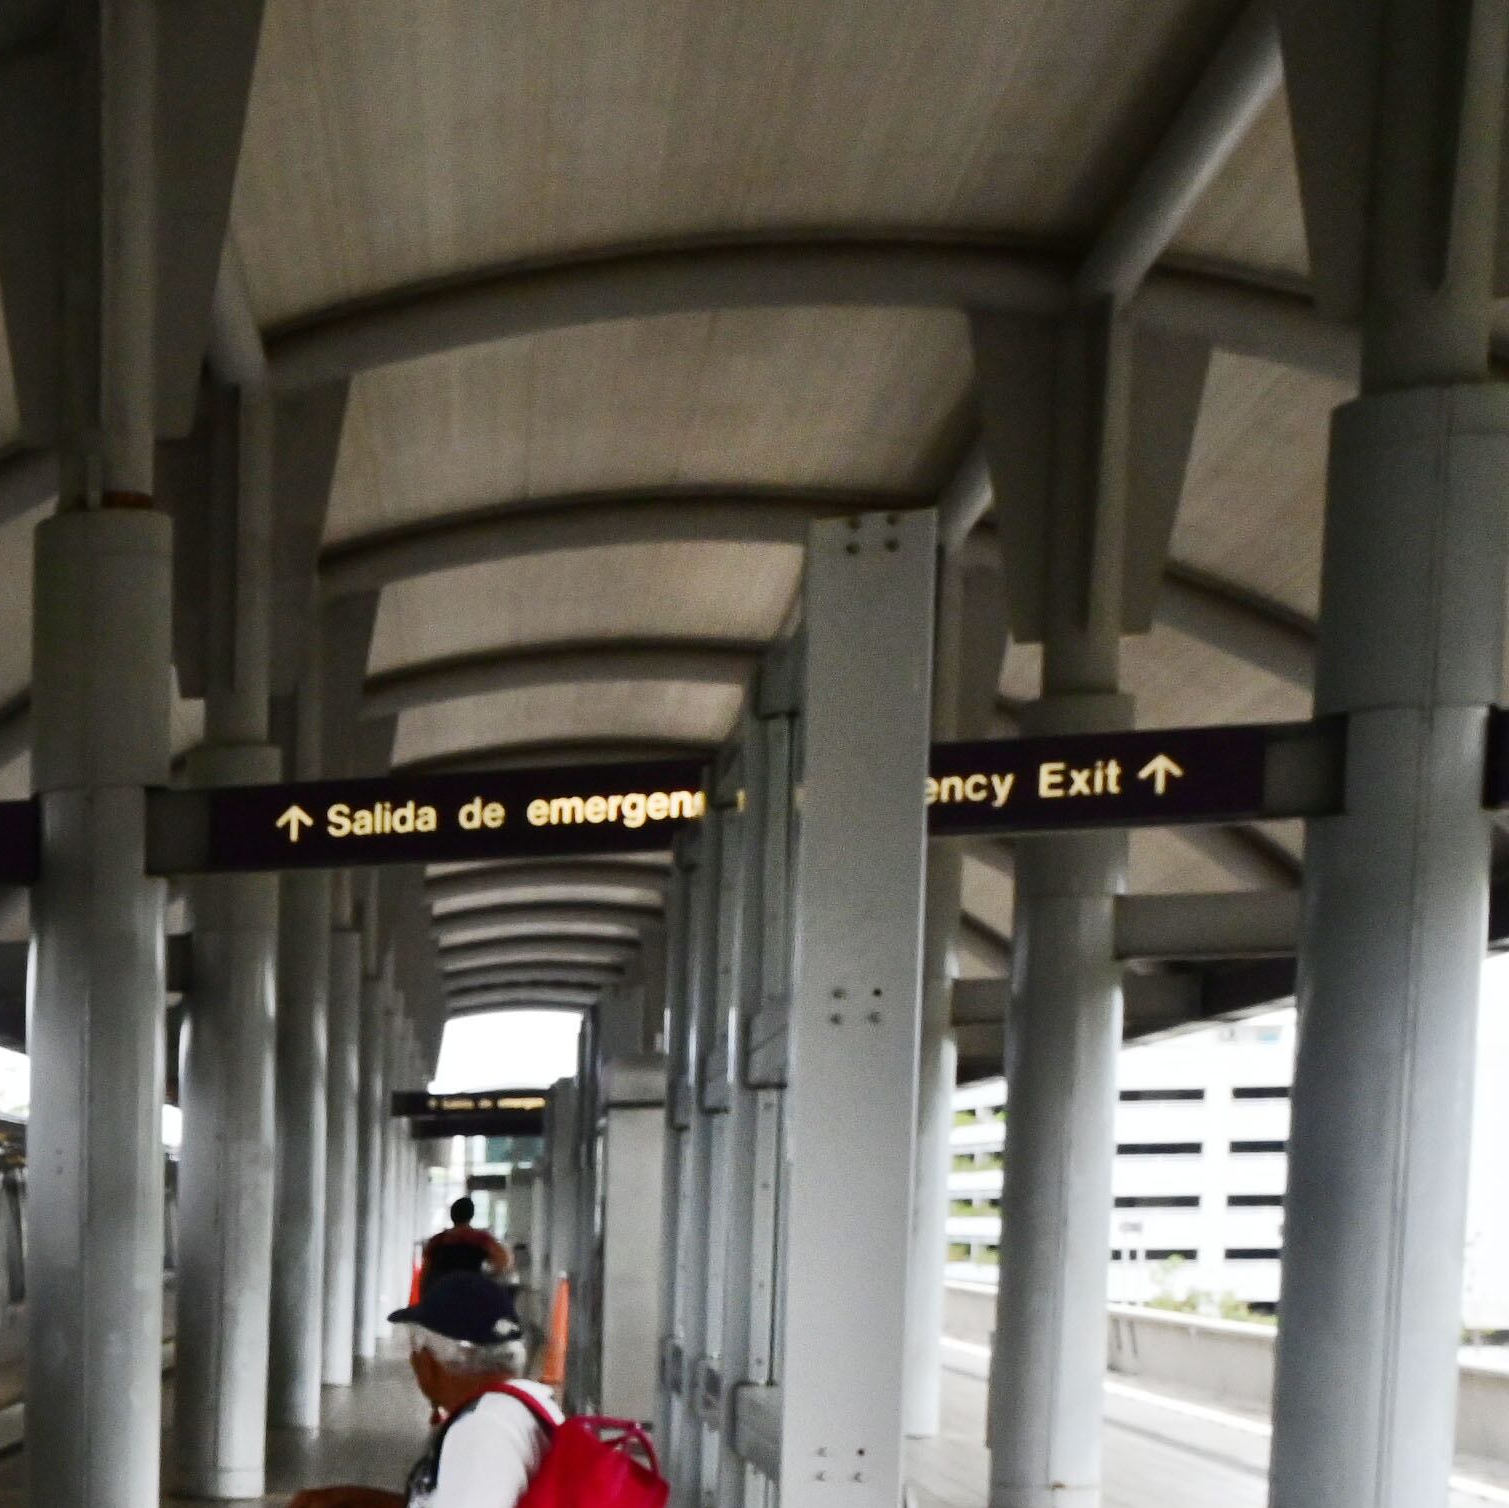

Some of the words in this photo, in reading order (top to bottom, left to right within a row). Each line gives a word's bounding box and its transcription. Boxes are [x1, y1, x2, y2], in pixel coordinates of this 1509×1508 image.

[1037, 758, 1122, 799] Exit
[326, 800, 437, 838] Salida
[458, 796, 506, 831] de
